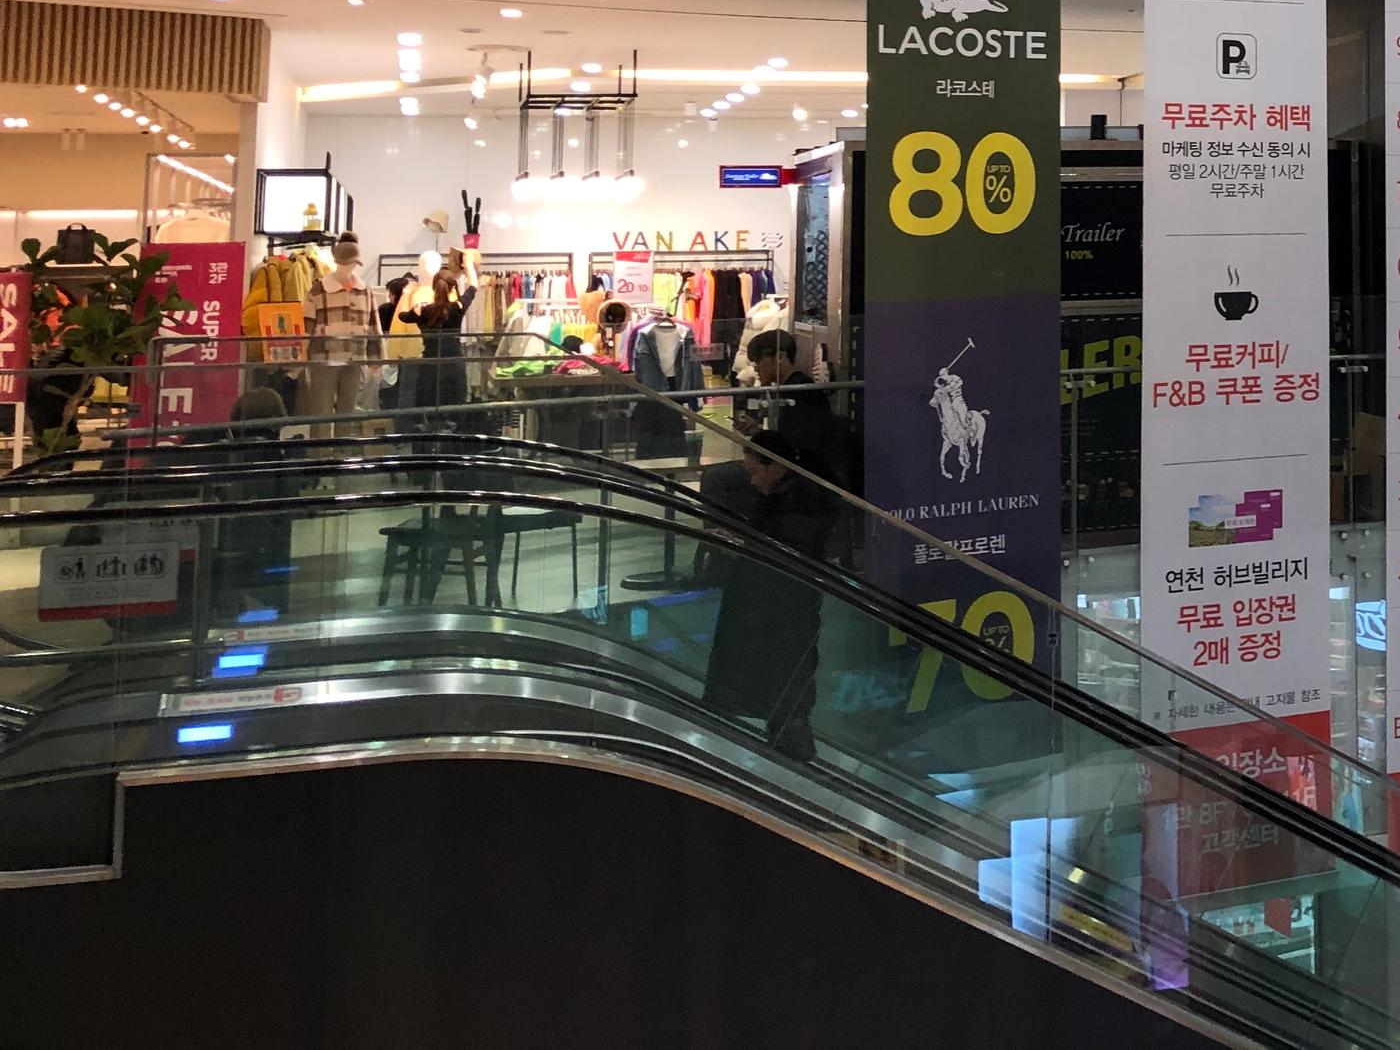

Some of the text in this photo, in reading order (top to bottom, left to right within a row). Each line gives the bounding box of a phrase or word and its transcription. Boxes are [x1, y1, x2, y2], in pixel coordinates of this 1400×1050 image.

[878, 24, 1047, 59] LACOSTE
[936, 79, 995, 98] 라코스테
[1161, 103, 1312, 131] 무료주차 혜택
[1162, 140, 1311, 159] 마케팅 정보 수신 동의 시
[1168, 163, 1305, 180] 평일 2시간/주말 1시간
[889, 131, 1036, 237] 80
[1209, 183, 1265, 199] 무료주차
[613, 230, 749, 250] VAN AKE
[1062, 222, 1125, 242] Trailer
[1065, 251, 1093, 260] 100%
[209, 274, 228, 284] 2F
[617, 279, 634, 294] 20
[200, 300, 220, 361] SUPER
[1185, 340, 1289, 372] 무료커피/
[1153, 372, 1321, 407] F&B 쿠폰 증정
[920, 494, 1040, 520] RALPH LAUREN
[1165, 556, 1309, 594] 연천 허브빌리지
[1177, 593, 1297, 633] 무료 입장권
[1193, 630, 1282, 667] 2매 증정
[1301, 689, 1321, 703] 참조
